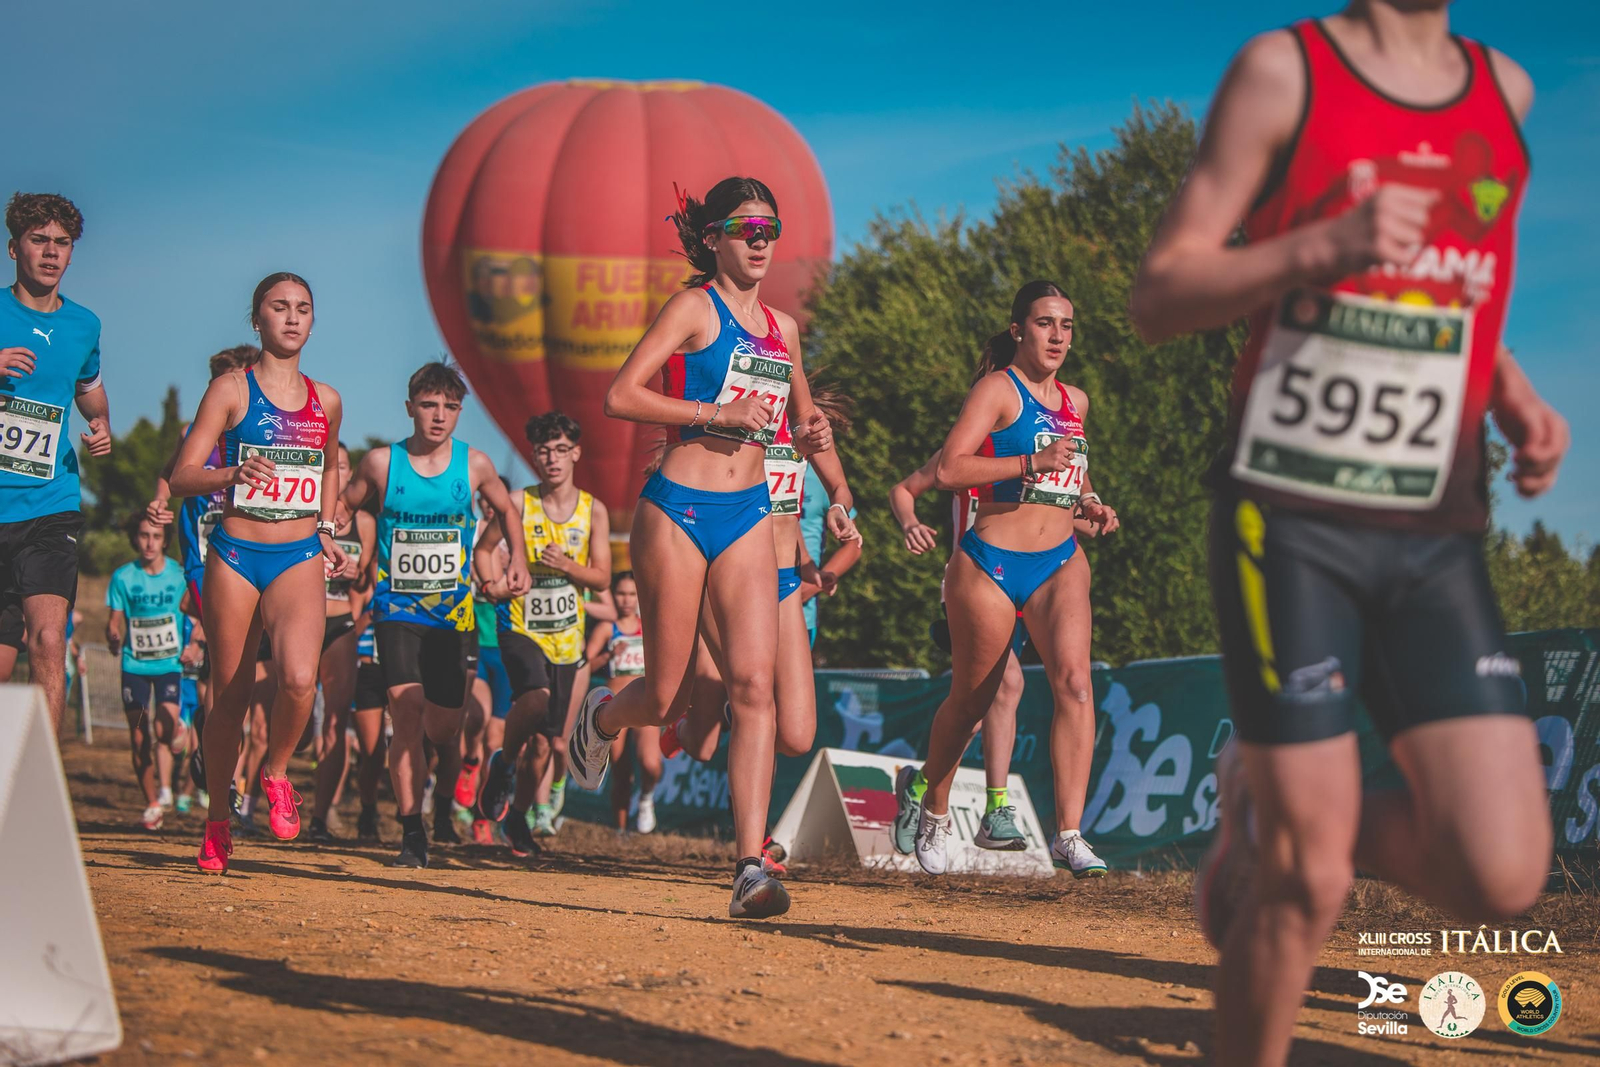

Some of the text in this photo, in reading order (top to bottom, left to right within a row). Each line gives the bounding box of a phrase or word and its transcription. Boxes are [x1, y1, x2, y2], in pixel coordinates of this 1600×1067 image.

[575, 261, 687, 297] FUERZ
[754, 361, 786, 376] ITÁLICA
[10, 400, 48, 416] ITÁLICA
[1270, 364, 1445, 449] 5952
[286, 419, 325, 430] lapalma
[265, 450, 304, 461] ITÁLICA
[765, 447, 788, 457] LICA
[245, 476, 317, 503] 7470
[769, 472, 797, 494] 71
[410, 531, 444, 541] ITÁLICA
[398, 553, 456, 574] 6005
[132, 590, 174, 607] nerja
[531, 593, 576, 615] 8108
[136, 631, 174, 649] 8114
